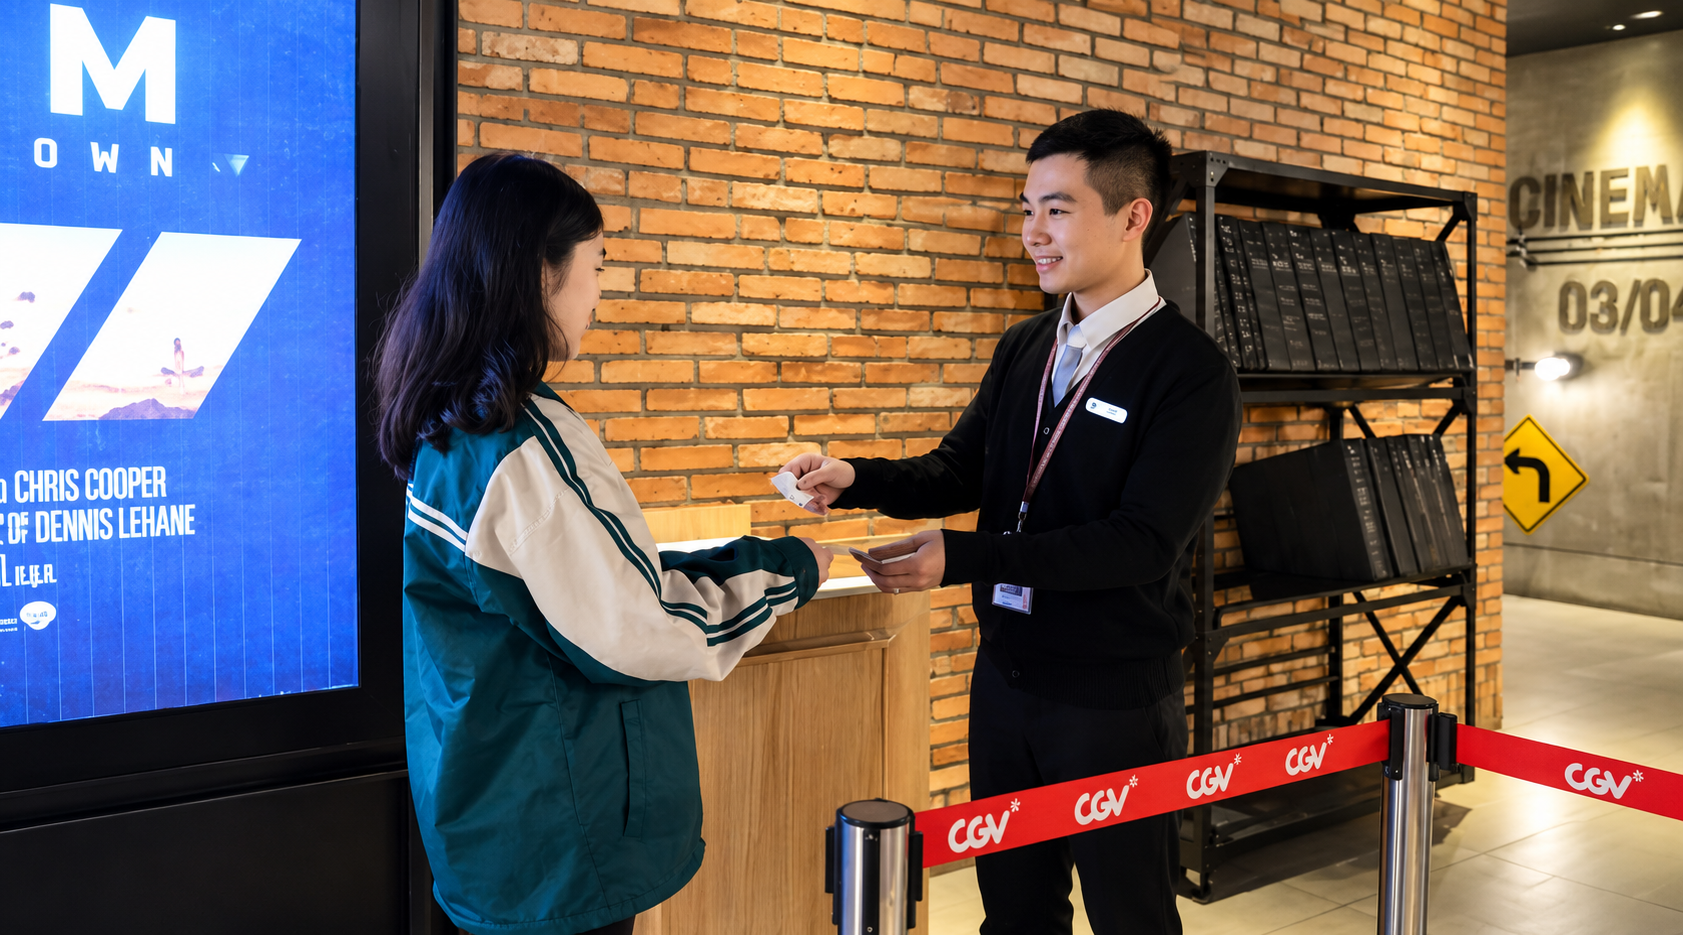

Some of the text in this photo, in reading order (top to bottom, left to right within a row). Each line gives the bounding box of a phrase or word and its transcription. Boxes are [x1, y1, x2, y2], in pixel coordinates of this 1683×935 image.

[1508, 163, 1683, 231] CINEM
[14, 468, 80, 503] CHRIS
[85, 466, 167, 502] COOPER
[35, 507, 114, 544] DENNIS
[118, 504, 196, 539] LEHANE
[1285, 742, 1327, 776] CGV
[1186, 762, 1234, 800] CGV
[1565, 762, 1633, 800] CGV
[1074, 785, 1130, 825] CGV
[947, 810, 1010, 853] CGV
